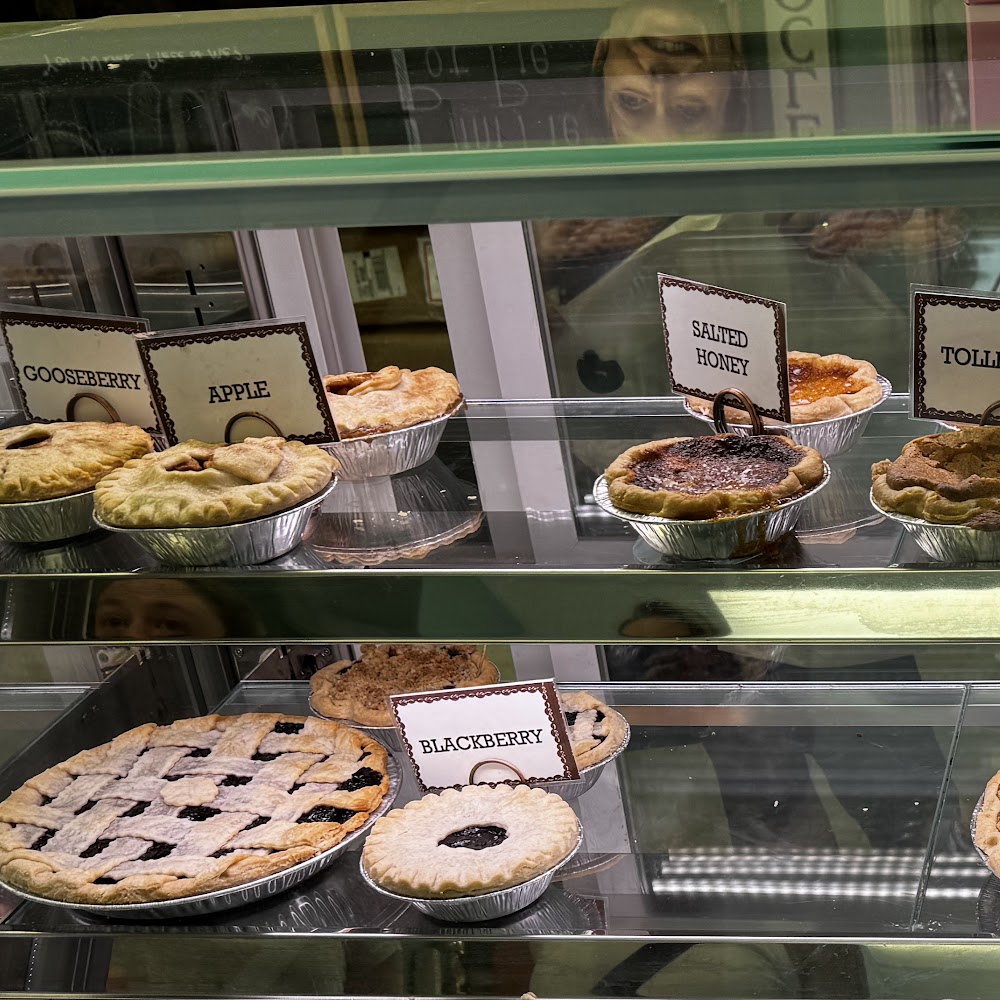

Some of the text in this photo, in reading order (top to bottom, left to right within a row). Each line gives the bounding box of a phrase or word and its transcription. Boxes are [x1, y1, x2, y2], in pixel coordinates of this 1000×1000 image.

[691, 320, 749, 349] SALTED
[695, 347, 749, 376] HONEY
[23, 365, 141, 390] GOOSEBERRY
[208, 380, 271, 404] APPLE
[419, 728, 543, 754] BLACKBERRY
